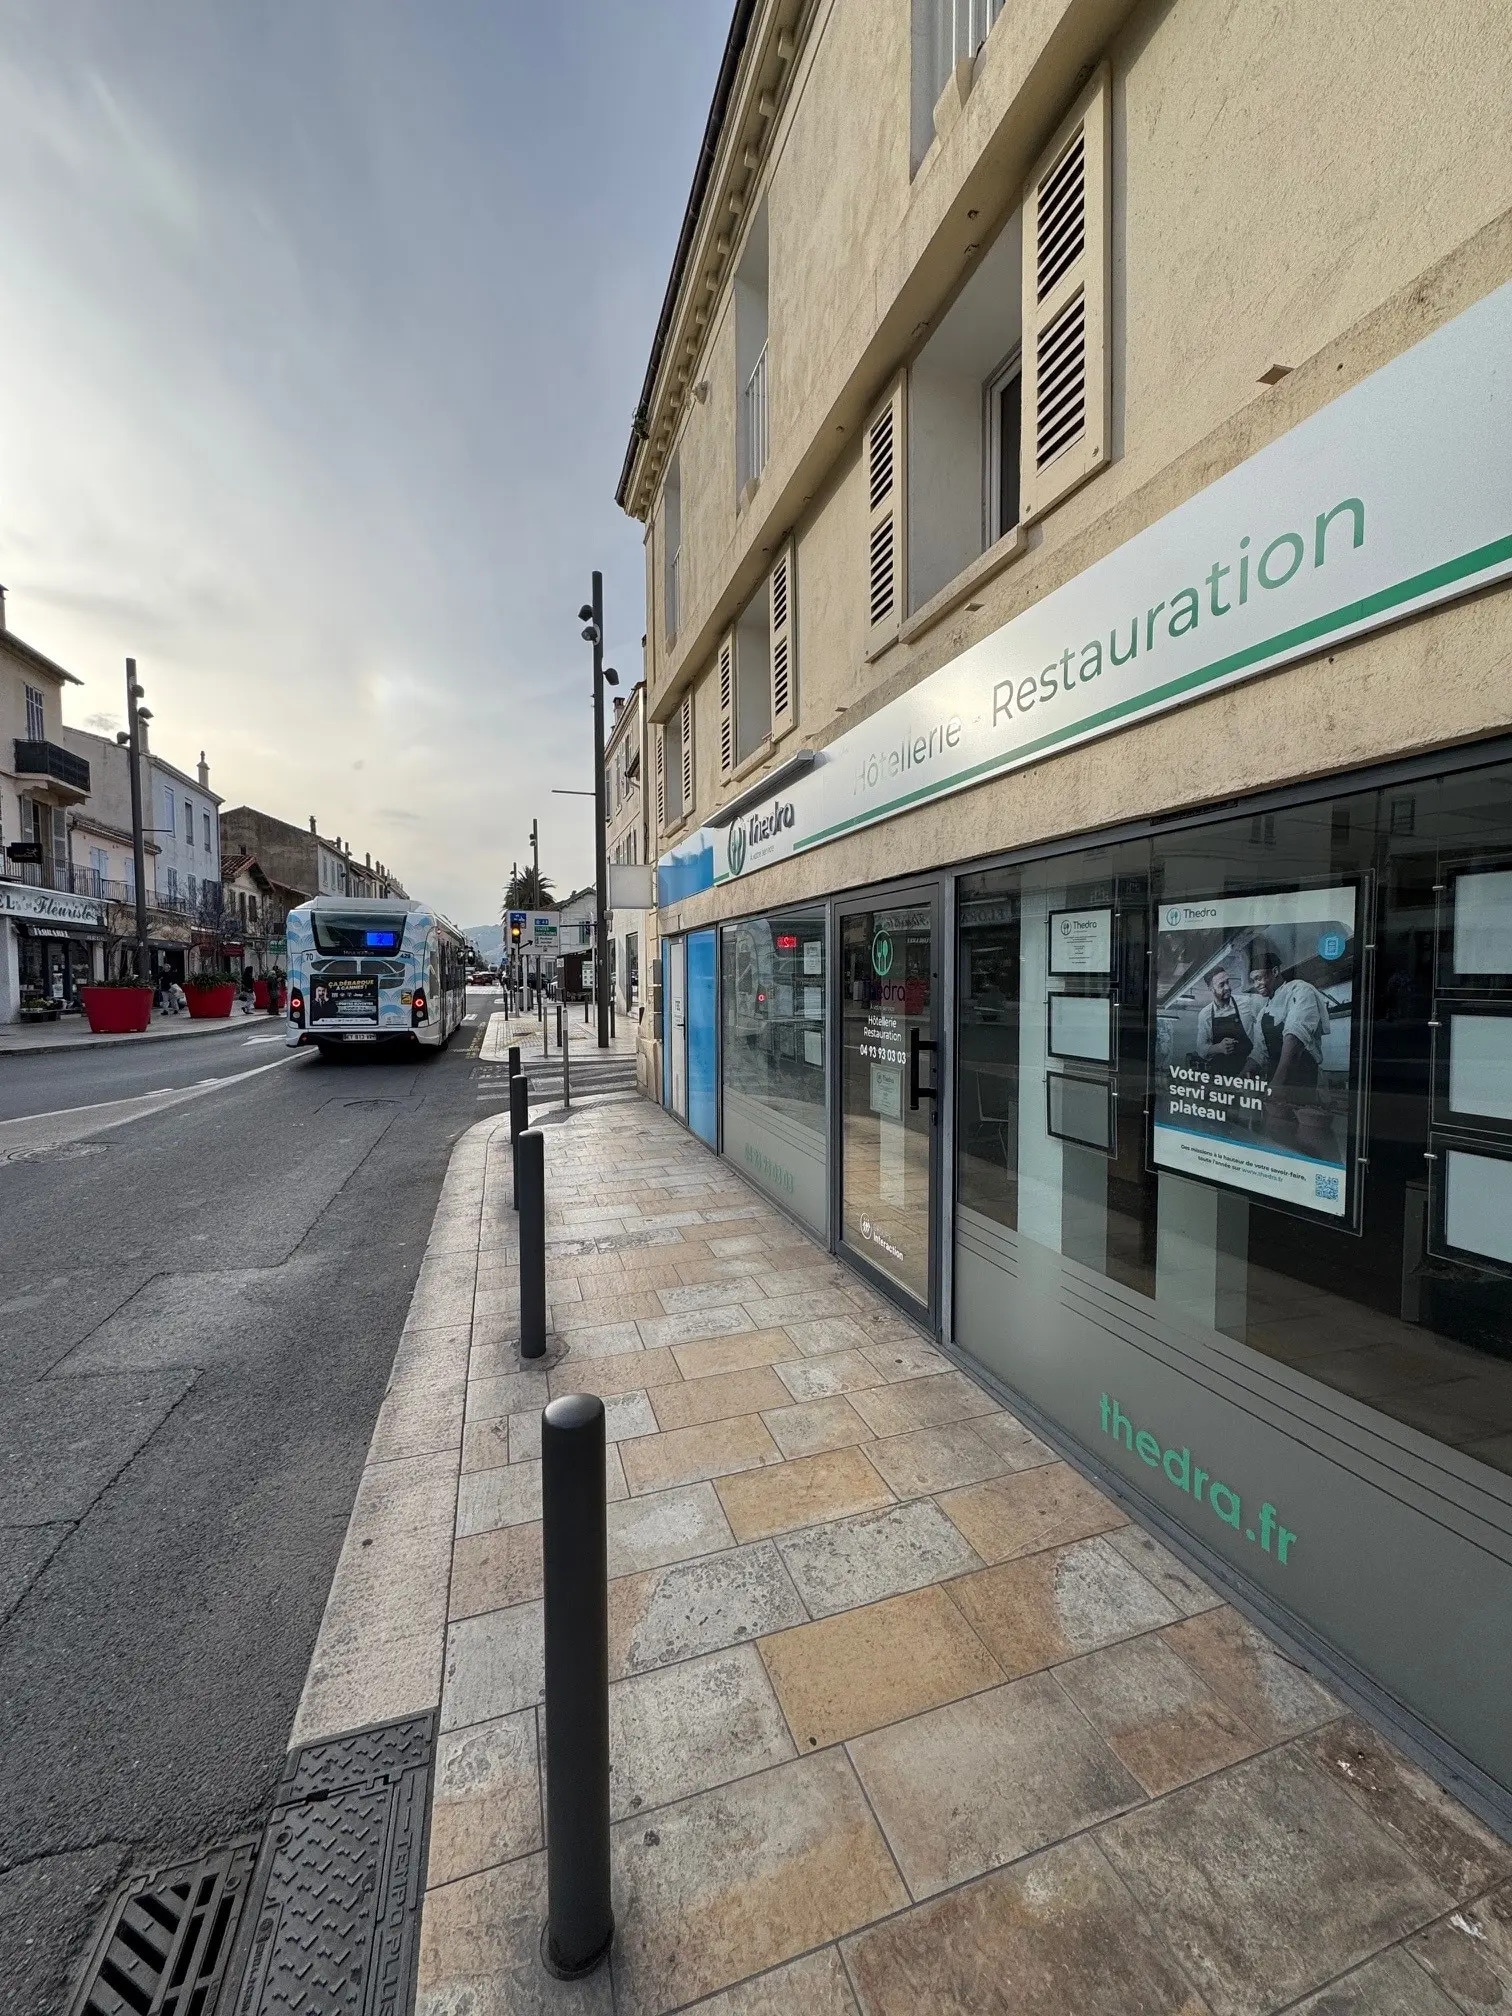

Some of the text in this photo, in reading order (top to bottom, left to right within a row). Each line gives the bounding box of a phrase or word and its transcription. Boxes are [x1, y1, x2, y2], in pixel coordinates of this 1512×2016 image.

[853, 716, 962, 796] Hôtellerie
[991, 497, 1365, 728] Restauration
[746, 801, 796, 846] Thedra
[33, 895, 98, 920] Fleuriste
[1183, 907, 1217, 919] Thedra
[1073, 920, 1097, 930] Thedra
[868, 1014, 897, 1028] Hôtellerie
[863, 1026, 902, 1042] Restauration
[860, 1044, 907, 1065] 04 93 93 03 03
[1169, 1065, 1272, 1096] Votre avenir,
[1169, 1084, 1262, 1111] servi sur un
[1169, 1100, 1226, 1122] plateau
[1191, 1147, 1213, 1157] missions
[1223, 1154, 1244, 1165] hauteur
[1254, 1163, 1270, 1171] votre
[1197, 1155, 1212, 1164] toute
[1100, 1392, 1298, 1566] thedra.fr
